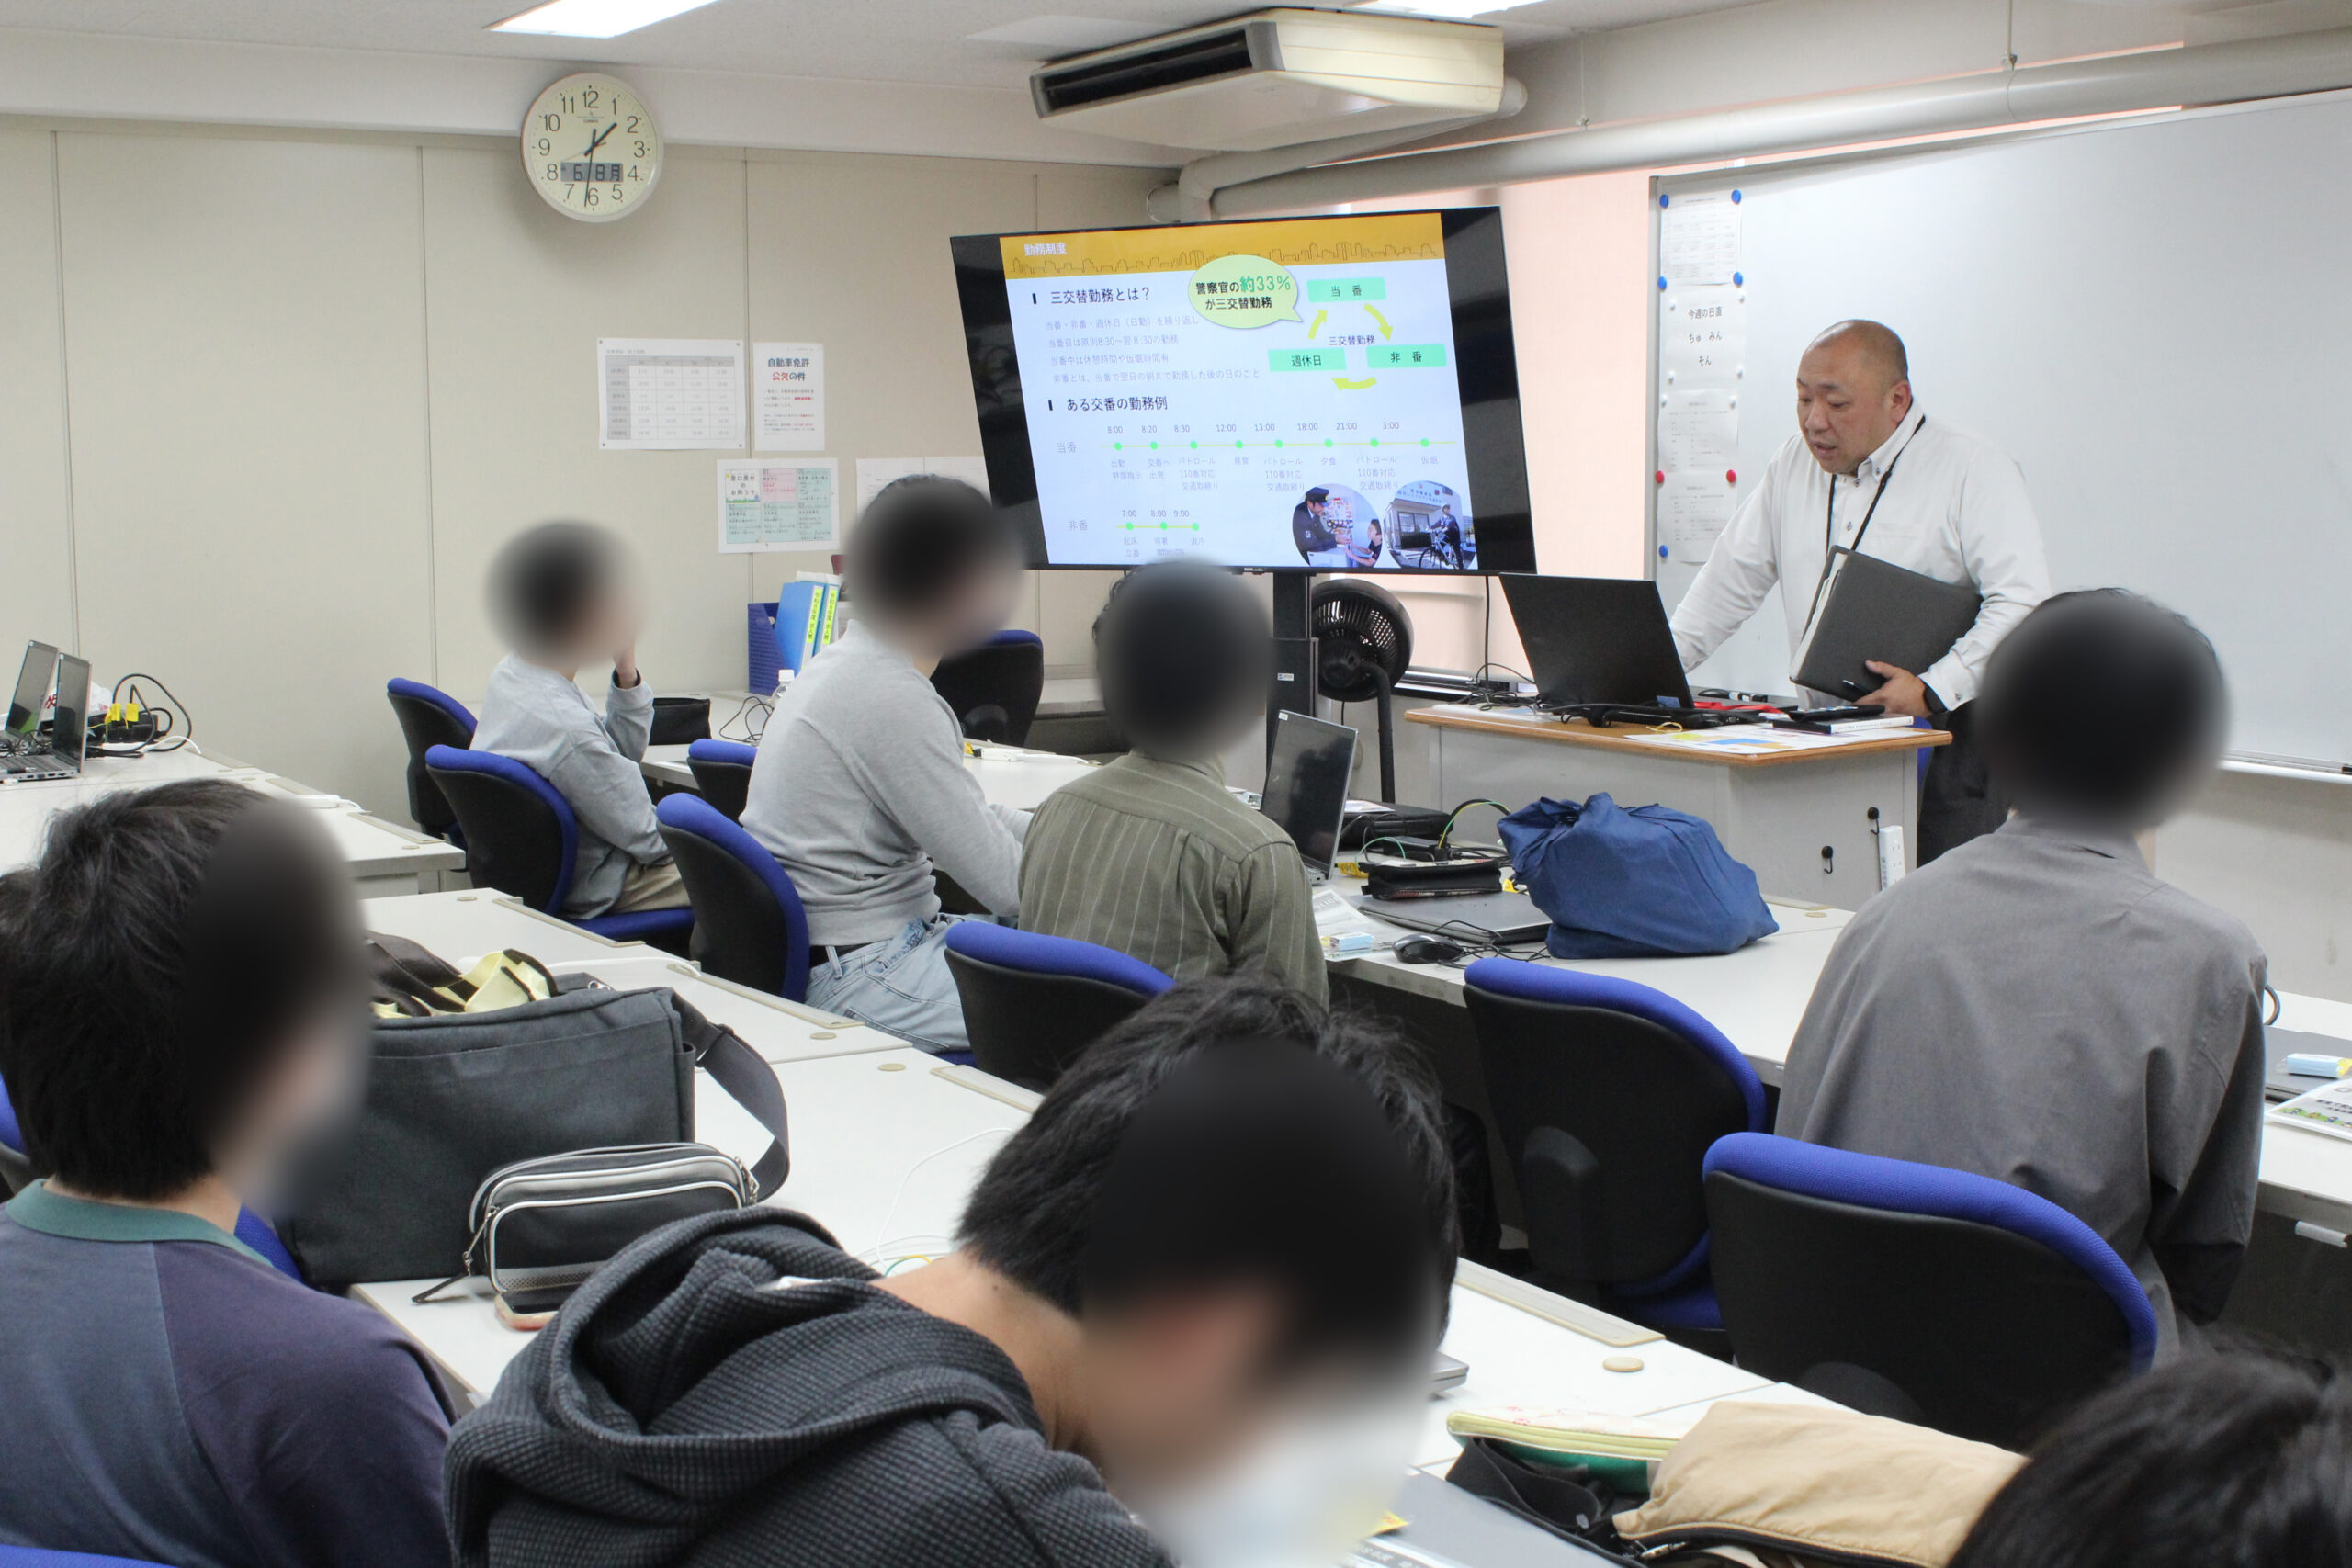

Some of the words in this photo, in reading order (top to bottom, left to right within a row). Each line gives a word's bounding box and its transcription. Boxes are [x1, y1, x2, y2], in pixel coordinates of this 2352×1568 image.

[561, 96, 574, 114] 11
[582, 90, 599, 108] 12
[612, 97, 616, 116] 1
[544, 113, 560, 131] 10
[627, 116, 639, 133] 2
[538, 139, 551, 156] 9
[633, 140, 645, 158] 3
[547, 164, 559, 181] 8
[628, 165, 638, 182] 4
[564, 183, 575, 199] 7
[587, 187, 599, 206] 6
[611, 184, 623, 200] 5
[1023, 242, 1068, 256] 勤務制度
[1205, 295, 1272, 310] が三交替勤務
[1687, 306, 1723, 320] 今週の日直
[1329, 334, 1375, 346] 三交替勤務
[767, 357, 810, 367] 自動車免許
[1291, 355, 1322, 367] 週休日
[772, 371, 806, 381] 公欠の件
[1067, 396, 1168, 412] ある交番の勤務例
[1107, 425, 1124, 434] 8:00
[1141, 424, 1158, 434] 8:20
[1174, 424, 1191, 434] 8:30
[1216, 423, 1237, 433] 12:00
[1254, 423, 1275, 432] 13:00
[1297, 422, 1318, 432] 18:00
[1336, 421, 1358, 431] 21:00
[1383, 421, 1400, 430] 3:00
[1057, 442, 1077, 454] 当番
[1122, 509, 1137, 518] 7:00
[1150, 509, 1167, 518] 8:00
[1173, 509, 1190, 518] 9:00
[1068, 519, 1088, 532] 非番
